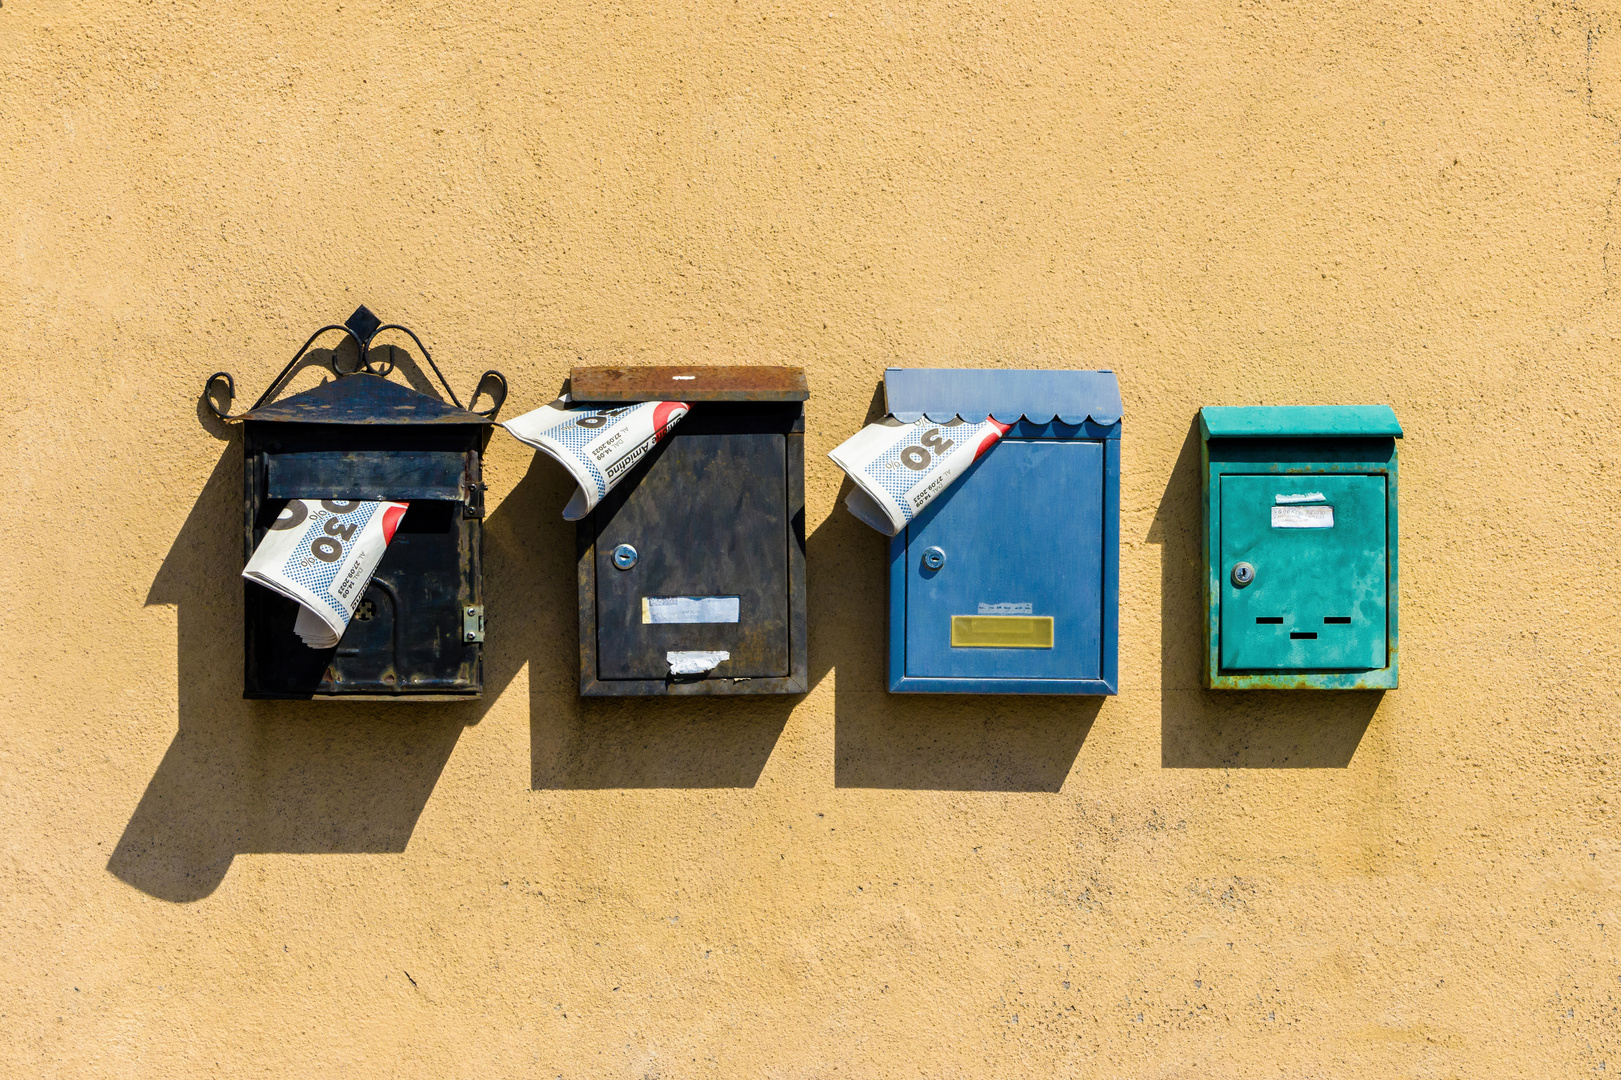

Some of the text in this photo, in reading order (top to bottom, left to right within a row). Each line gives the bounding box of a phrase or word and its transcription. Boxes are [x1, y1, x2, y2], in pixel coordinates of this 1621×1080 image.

[592, 433, 622, 455] 27.09.2023
[596, 447, 613, 461] 14.09
[607, 442, 649, 478] Amiatina
[913, 476, 943, 503] 27.09.2023
[915, 493, 932, 508] 14.09
[337, 560, 361, 596] 27.09.2023
[342, 581, 355, 599] 14.09
